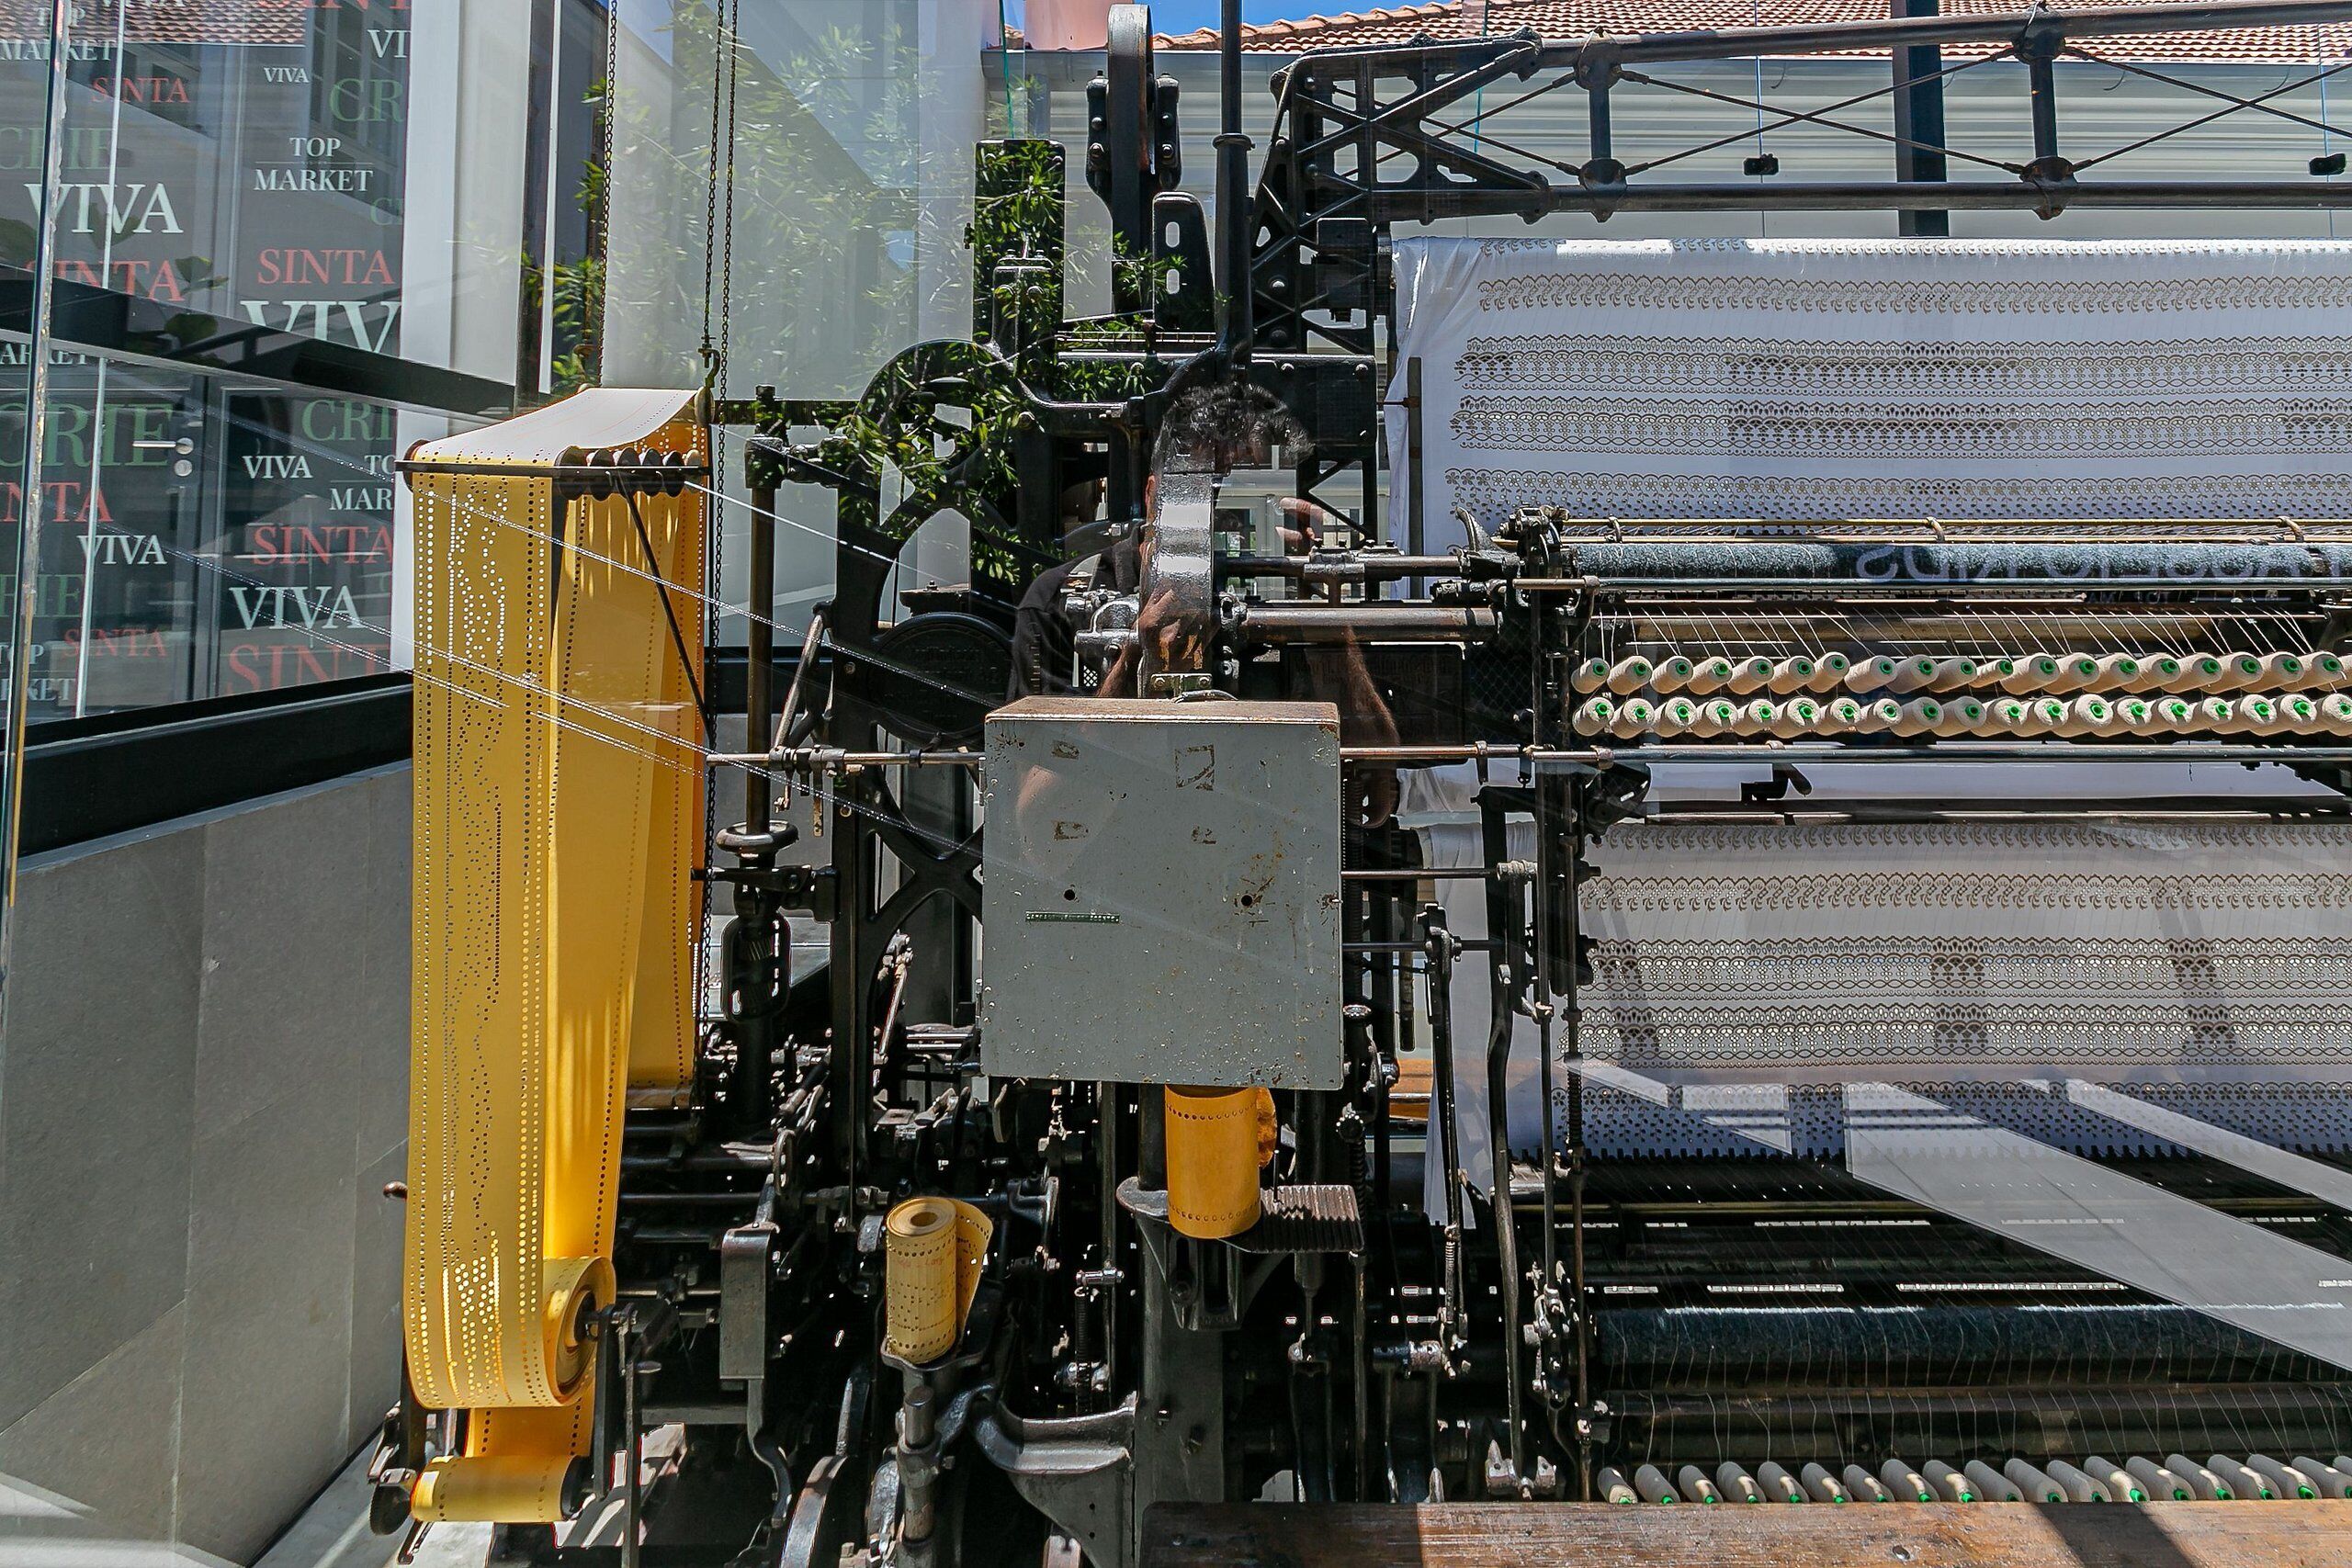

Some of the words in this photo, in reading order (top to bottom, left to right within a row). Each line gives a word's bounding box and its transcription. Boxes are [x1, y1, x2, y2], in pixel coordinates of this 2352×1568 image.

[36, 7, 86, 27] TP
[0, 39, 116, 61] MAET
[264, 67, 310, 83] VIVA
[91, 76, 189, 103] SNTA
[289, 138, 341, 157] TOP
[254, 169, 373, 192] MARKET
[24, 183, 184, 233] VIVA
[24, 260, 185, 301] NTA
[257, 249, 396, 285] SINTA
[243, 456, 313, 479] VIVA
[76, 535, 168, 565] VIVA
[253, 525, 392, 565] SINTA
[229, 585, 368, 630] VIVA
[0, 644, 44, 665] TP
[61, 628, 169, 657] SNTA
